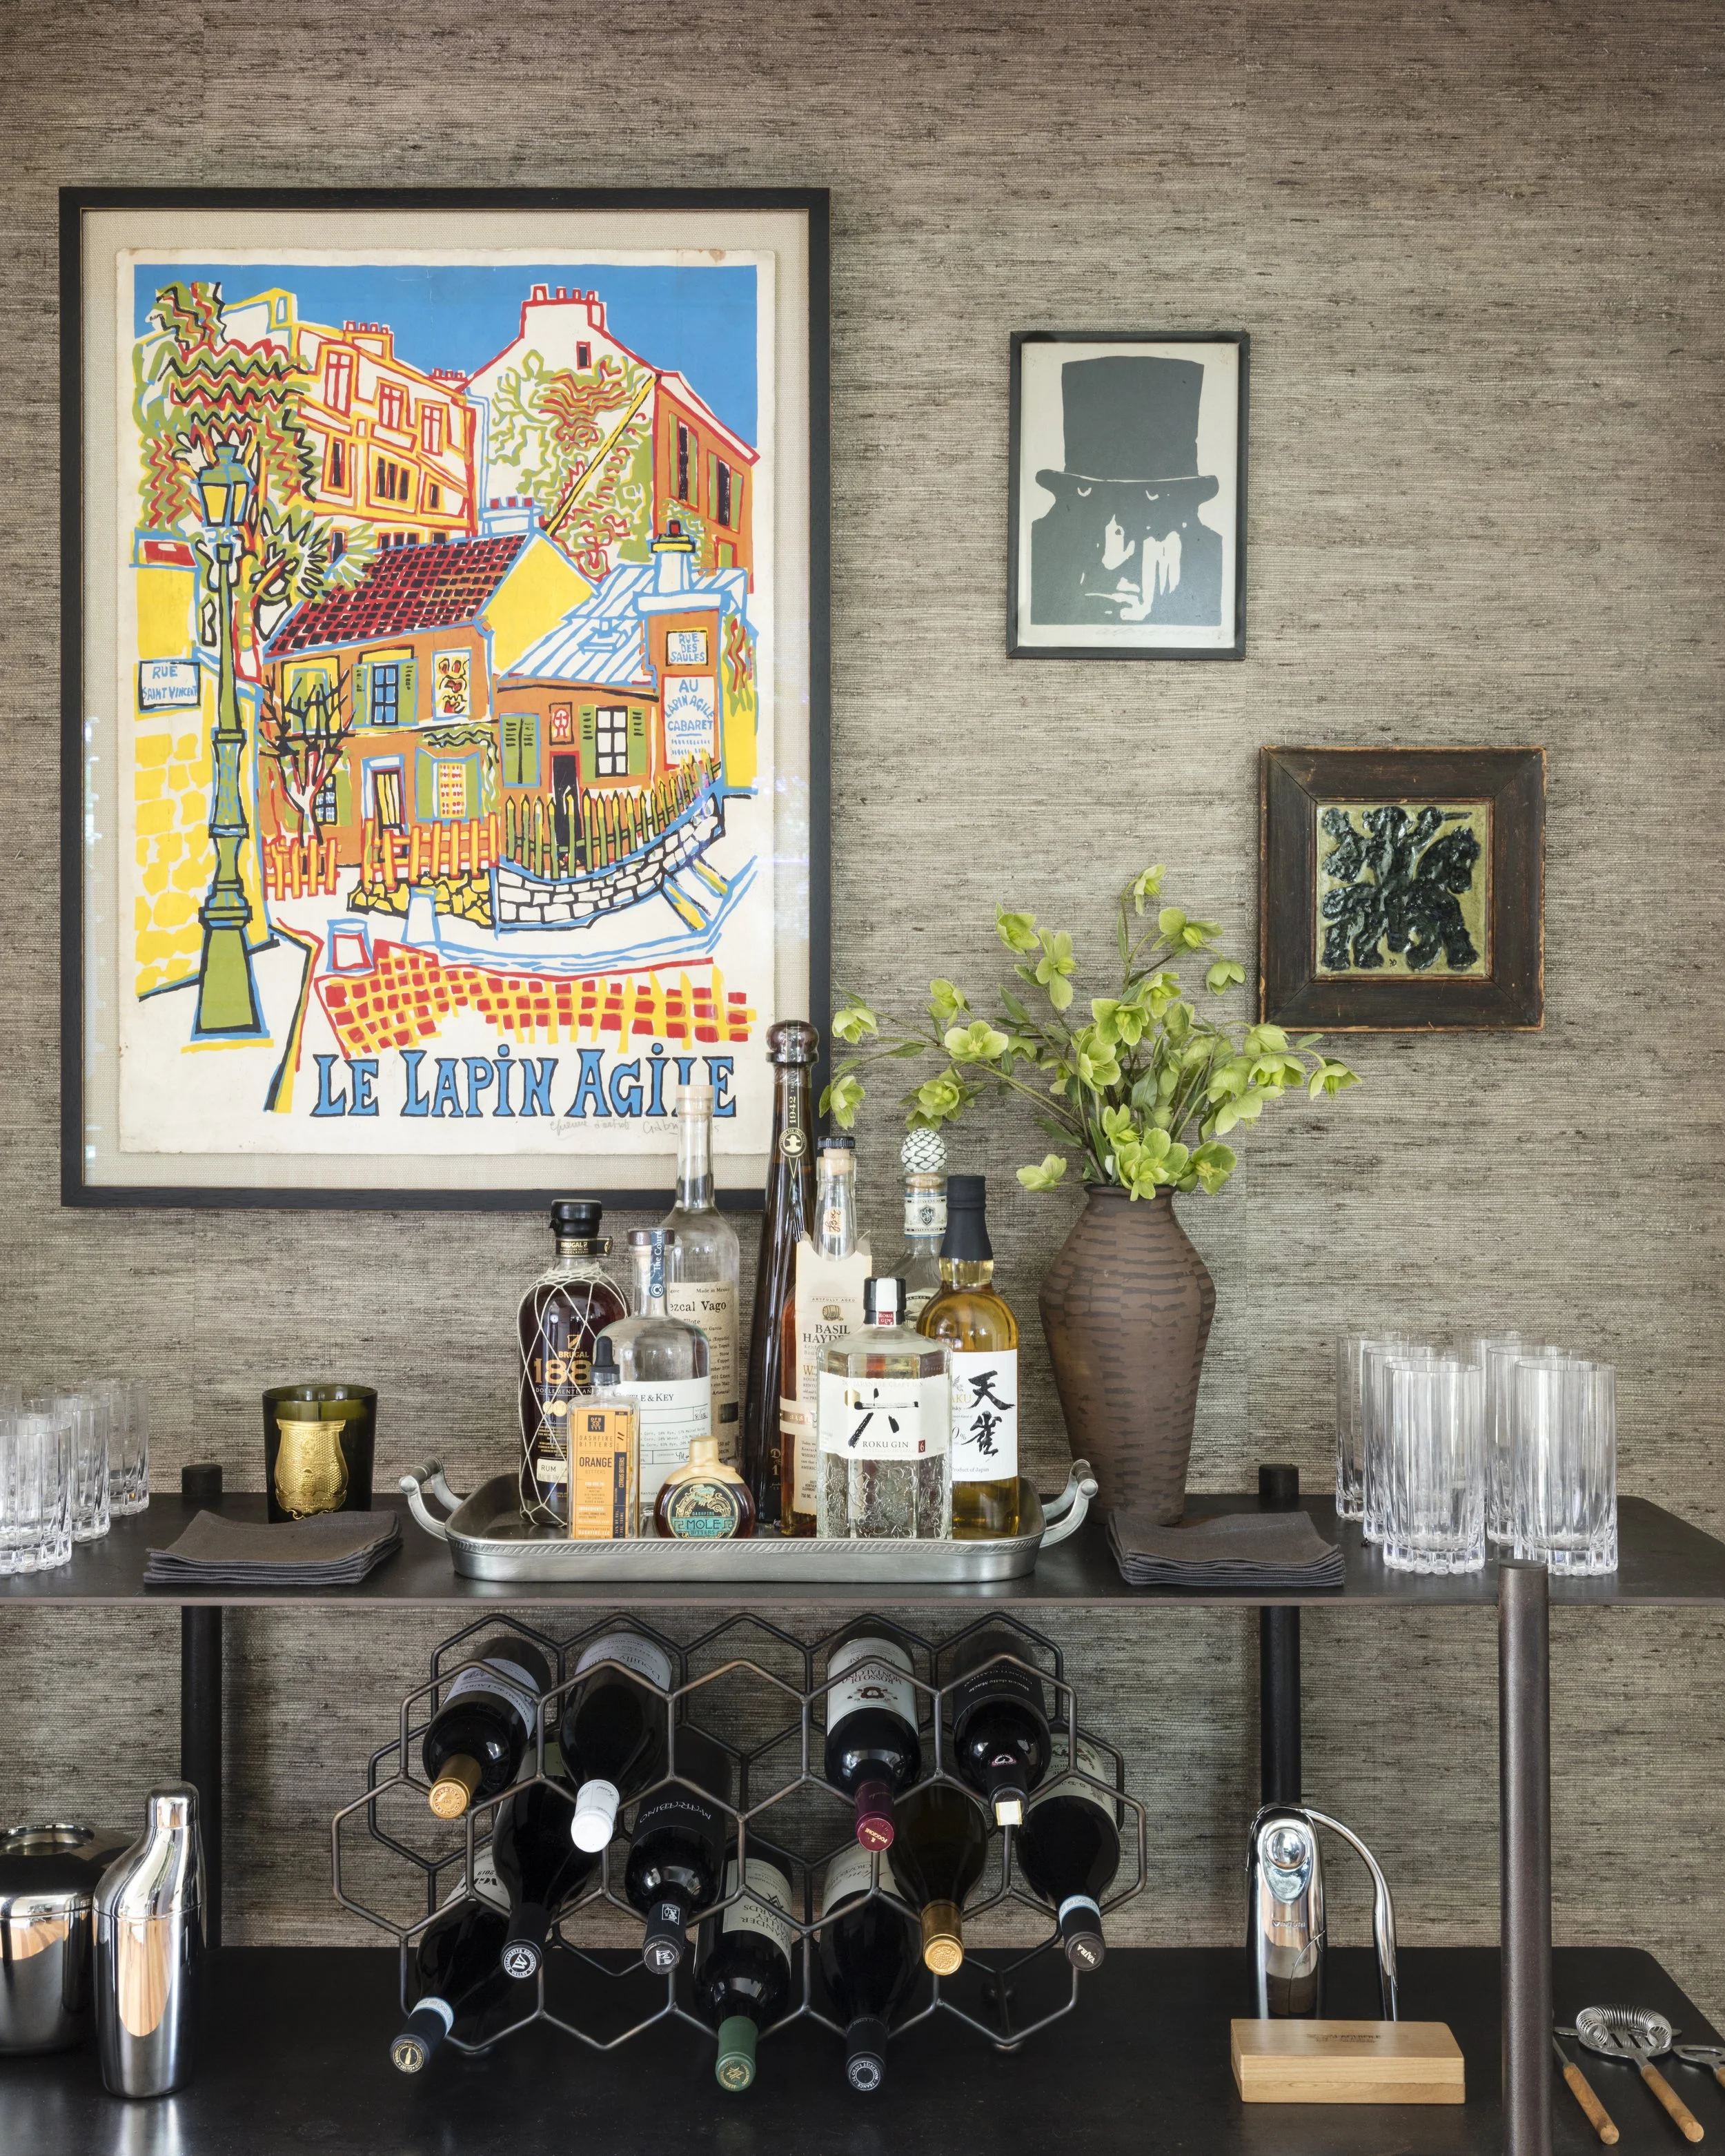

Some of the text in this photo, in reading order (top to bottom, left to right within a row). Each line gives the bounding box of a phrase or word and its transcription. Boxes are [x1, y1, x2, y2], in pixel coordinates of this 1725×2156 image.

[679, 633, 700, 643] RUE
[681, 643, 697, 653] DES
[670, 651, 704, 663] SAULES
[152, 665, 178, 679] RUE
[679, 679, 698, 693] AU
[142, 687, 167, 700] SAINT
[665, 695, 715, 719] LAPIN AGILE
[667, 720, 713, 731] CABARET
[310, 1053, 379, 1117] LE
[399, 1043, 558, 1117] LAPIN
[670, 1301, 727, 1313] ezcal Vago
[815, 1324, 851, 1334] BASIL
[802, 1333, 844, 1343] HAYD
[534, 1358, 592, 1385] 188
[848, 1388, 919, 1449] 六
[580, 1457, 612, 1467] ORANGE
[687, 1520, 721, 1530] MOLE
[863, 1675, 894, 1684] ROSSO
